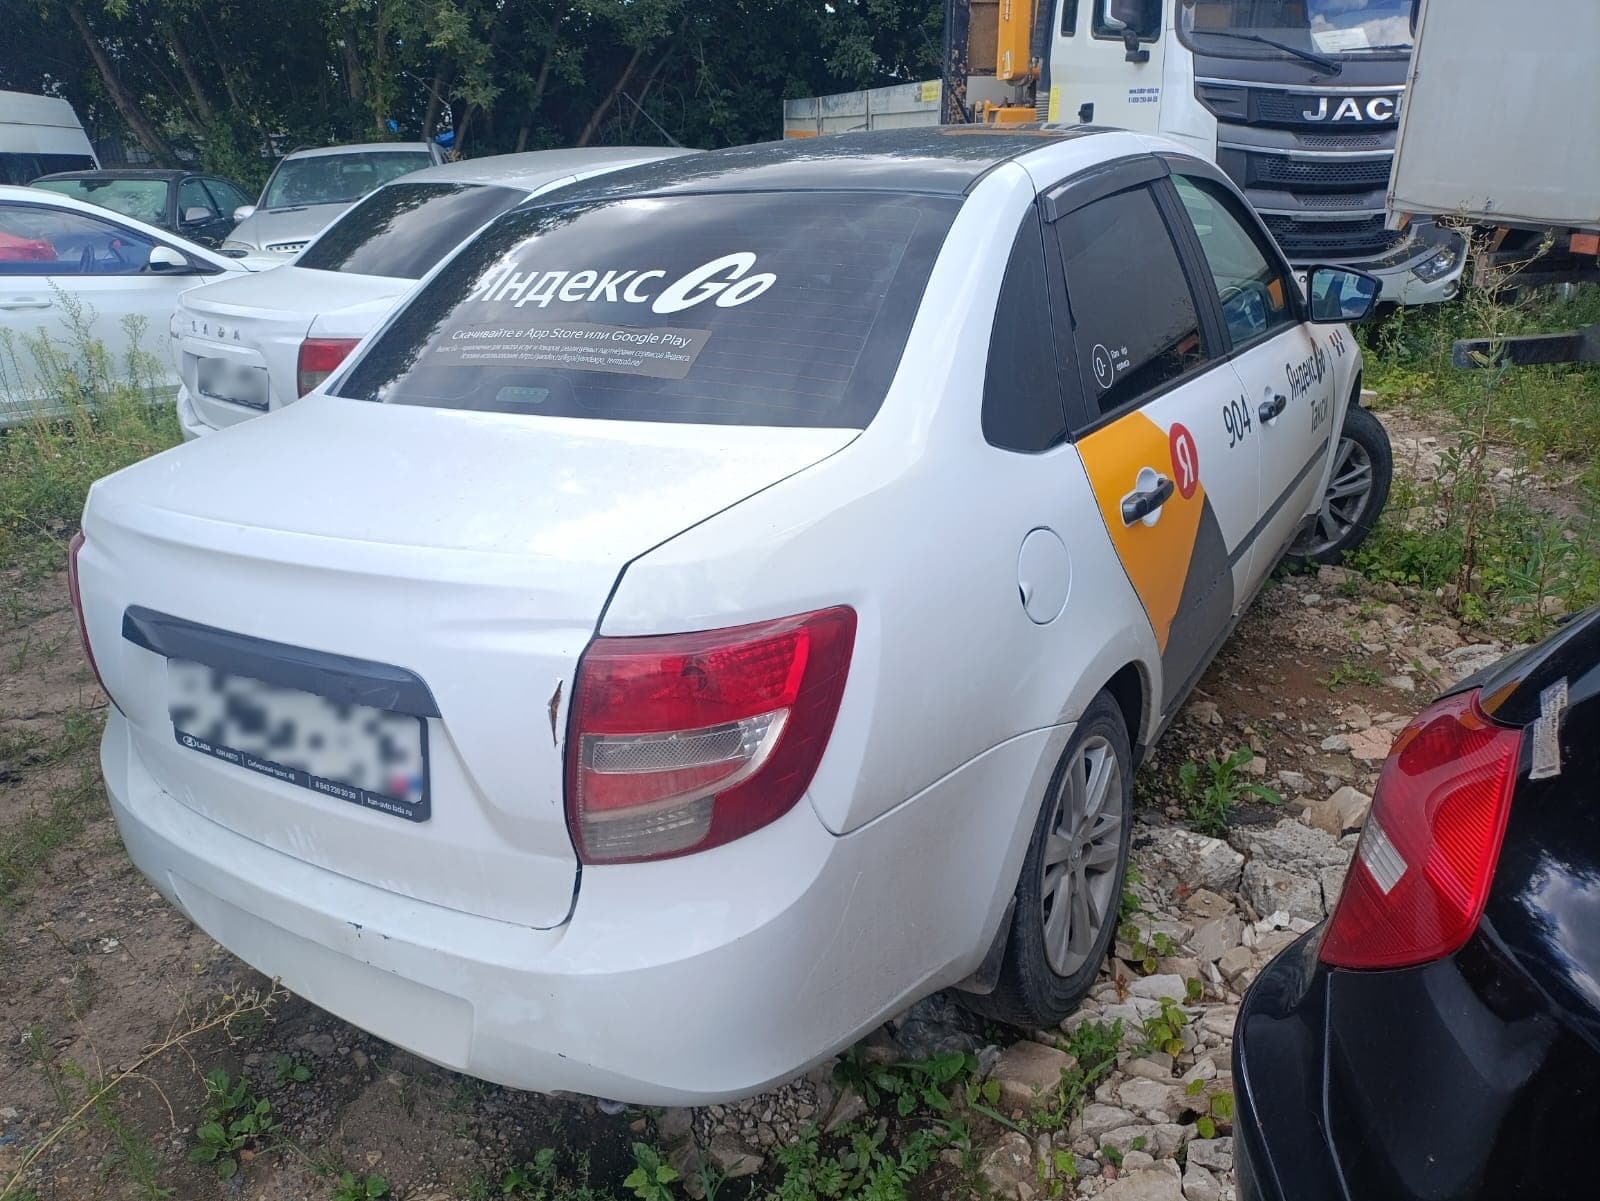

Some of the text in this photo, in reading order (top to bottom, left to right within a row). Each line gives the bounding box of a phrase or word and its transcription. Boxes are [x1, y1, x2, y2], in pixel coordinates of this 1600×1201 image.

[1303, 97, 1394, 121] JAC
[652, 252, 777, 314] Go
[452, 327, 692, 349] Скачивайте в App Store или Google Play
[1286, 355, 1317, 401] Яндекс
[1223, 394, 1252, 449] 904
[1176, 434, 1195, 490] Я
